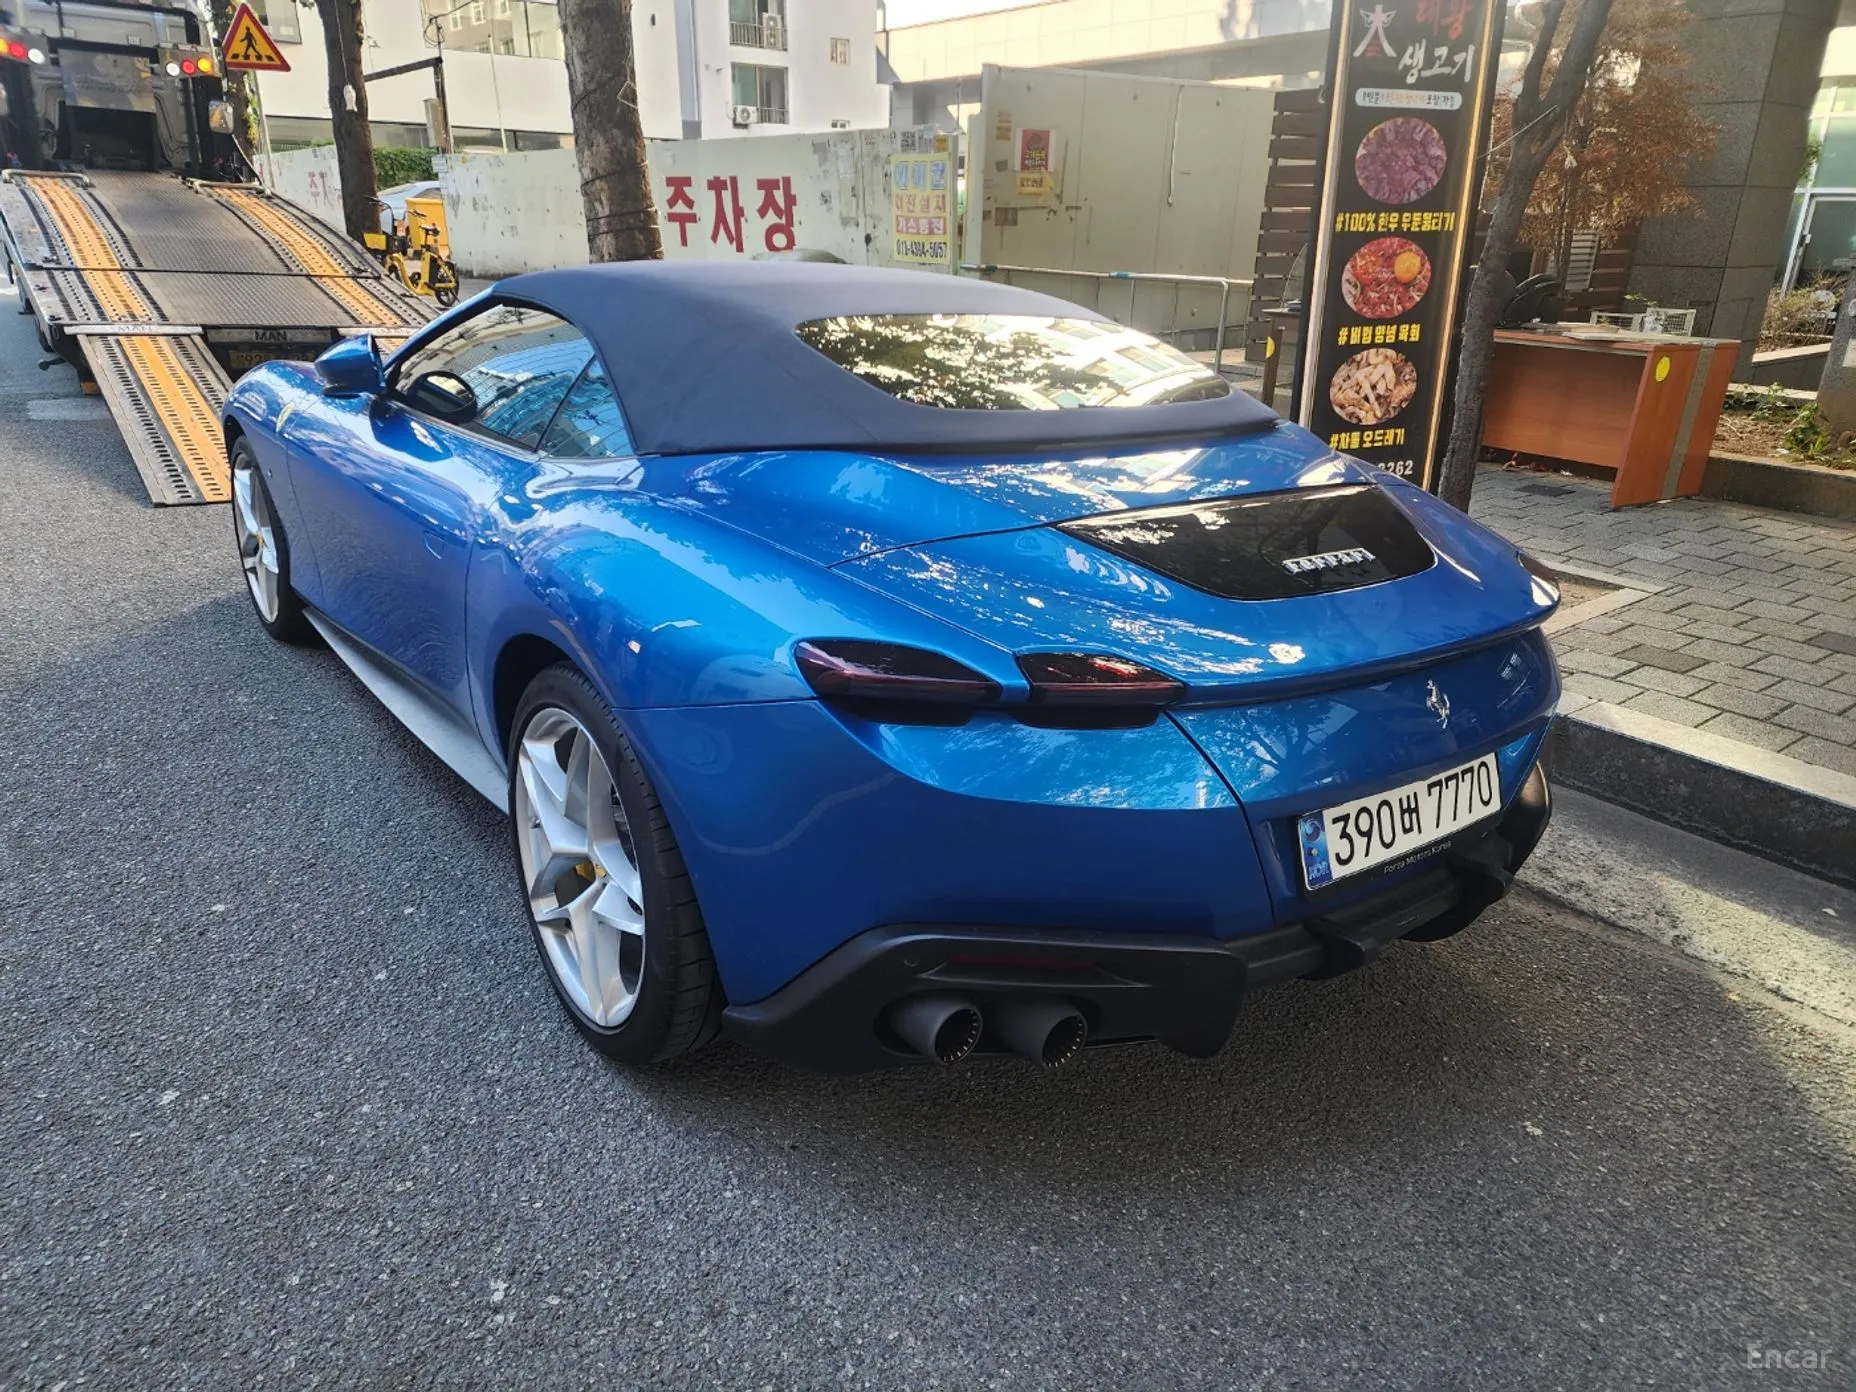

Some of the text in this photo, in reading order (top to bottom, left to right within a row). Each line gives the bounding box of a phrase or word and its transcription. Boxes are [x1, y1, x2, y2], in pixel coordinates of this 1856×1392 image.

[1398, 39, 1475, 84] 생고기
[666, 176, 798, 253] 주차장
[1335, 212, 1376, 232] #100%
[1378, 212, 1399, 232] 한우
[254, 330, 288, 342] MAN
[1350, 326, 1373, 344] 비법
[1375, 325, 1397, 343] 양념
[1399, 323, 1421, 342] 육회
[1362, 428, 1405, 448] 오드레기
[1282, 548, 1376, 575] Ferrari
[1332, 761, 1492, 866] 390버 7770
[1308, 861, 1331, 880] KOR
[1384, 860, 1405, 875] Forza
